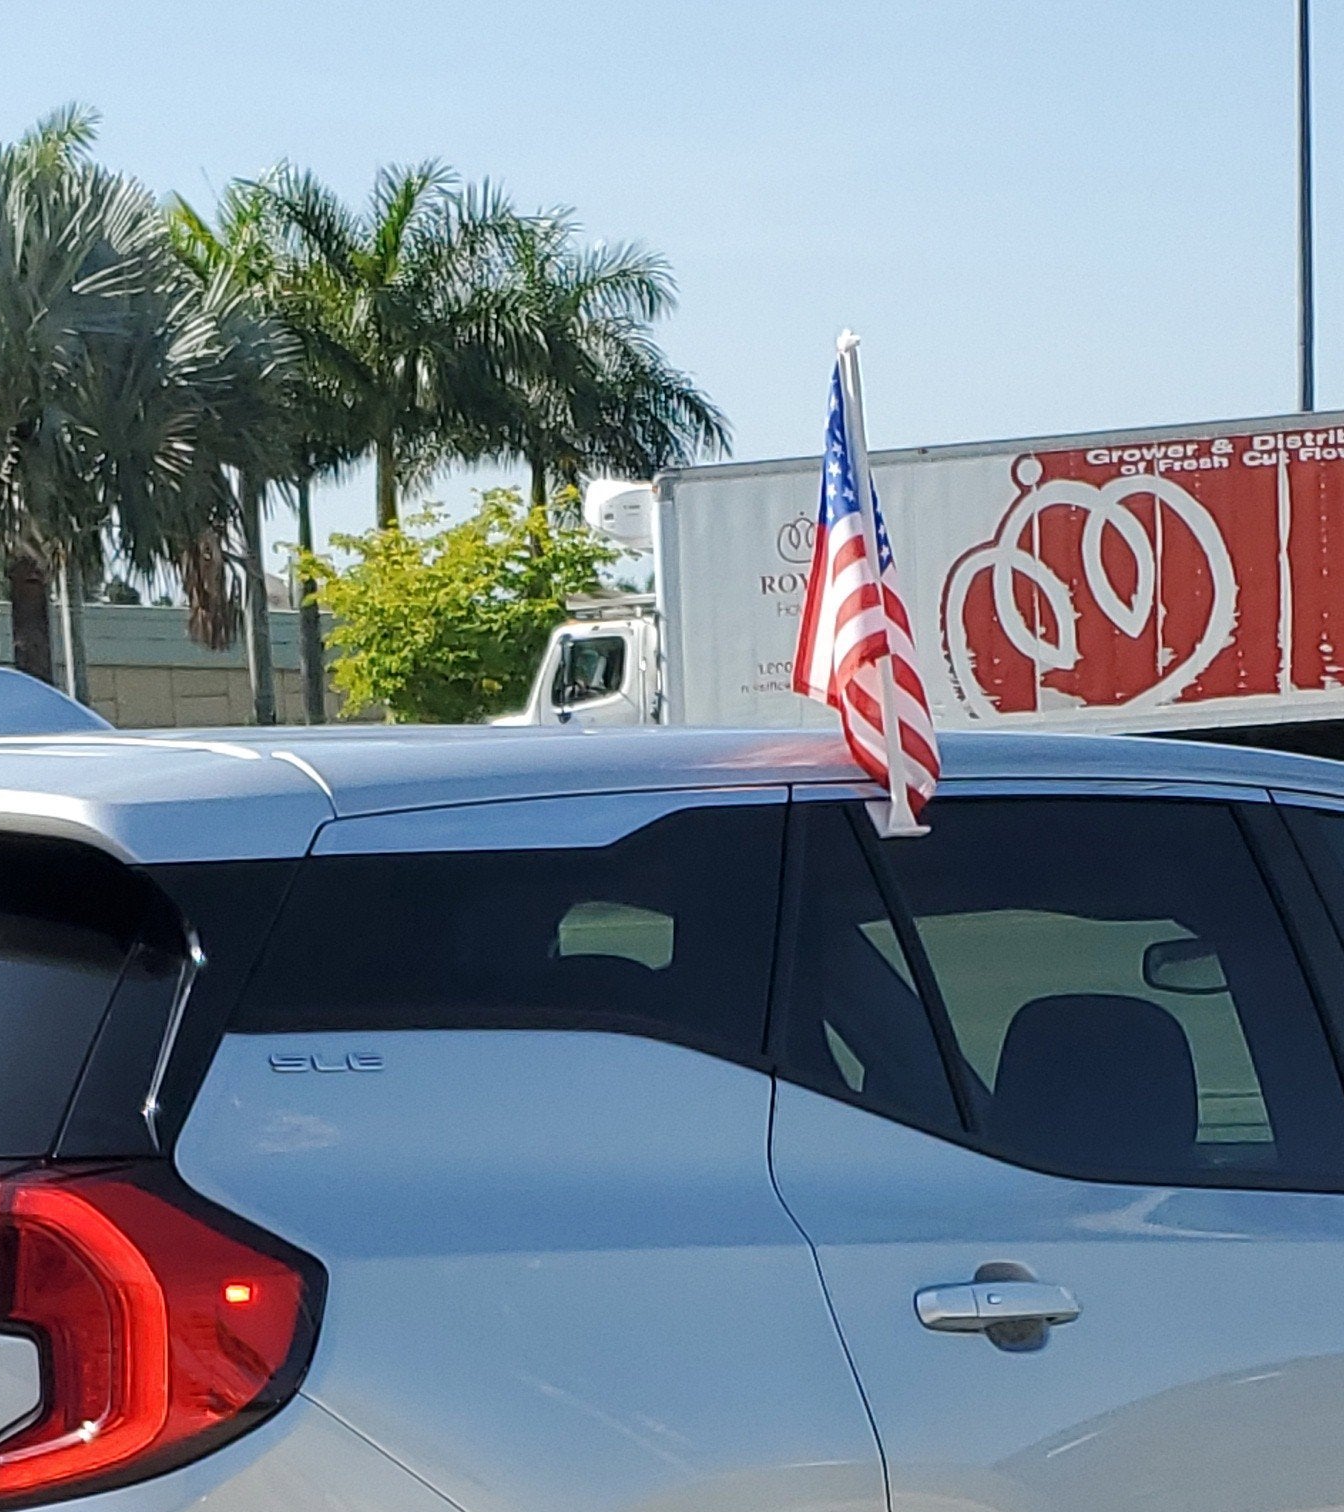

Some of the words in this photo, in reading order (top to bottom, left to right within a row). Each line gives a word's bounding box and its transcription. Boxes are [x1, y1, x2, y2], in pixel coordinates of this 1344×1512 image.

[1086, 443, 1198, 466] Grower
[1211, 438, 1234, 455] &
[1120, 461, 1147, 476] of
[1158, 455, 1229, 473] Fresh
[1242, 450, 1290, 467] Cut
[268, 1052, 385, 1072] SLE
